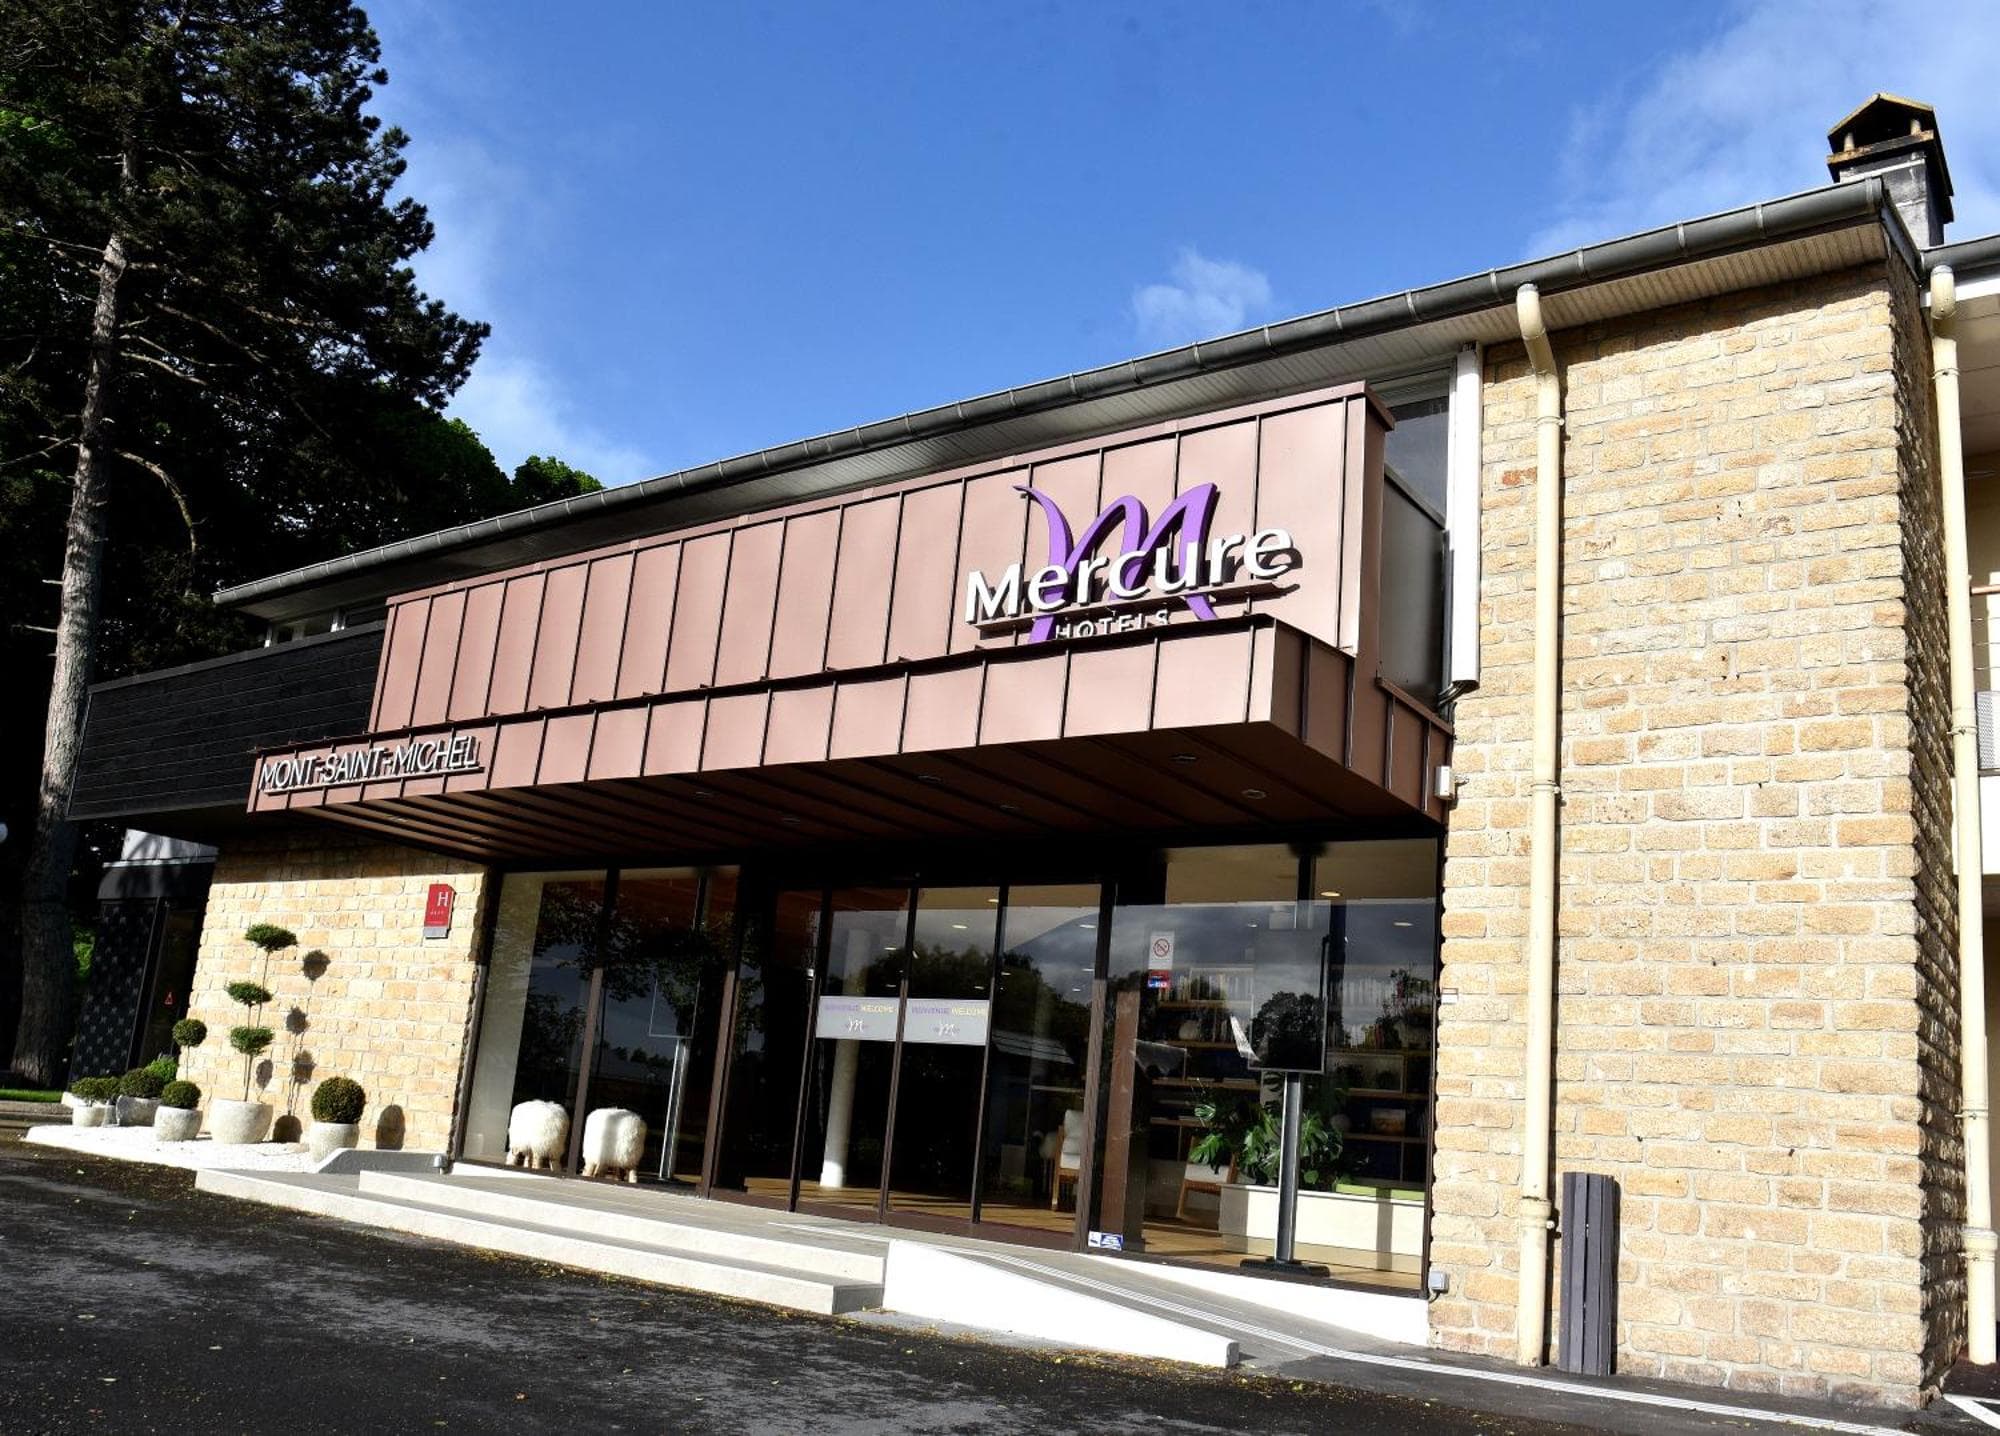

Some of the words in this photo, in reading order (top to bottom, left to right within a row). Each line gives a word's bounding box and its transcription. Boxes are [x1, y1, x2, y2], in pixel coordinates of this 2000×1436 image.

[965, 528, 1294, 624] Mercure
[258, 735, 478, 790] MONT-SAINT-MICHEL
[437, 891, 449, 907] H
